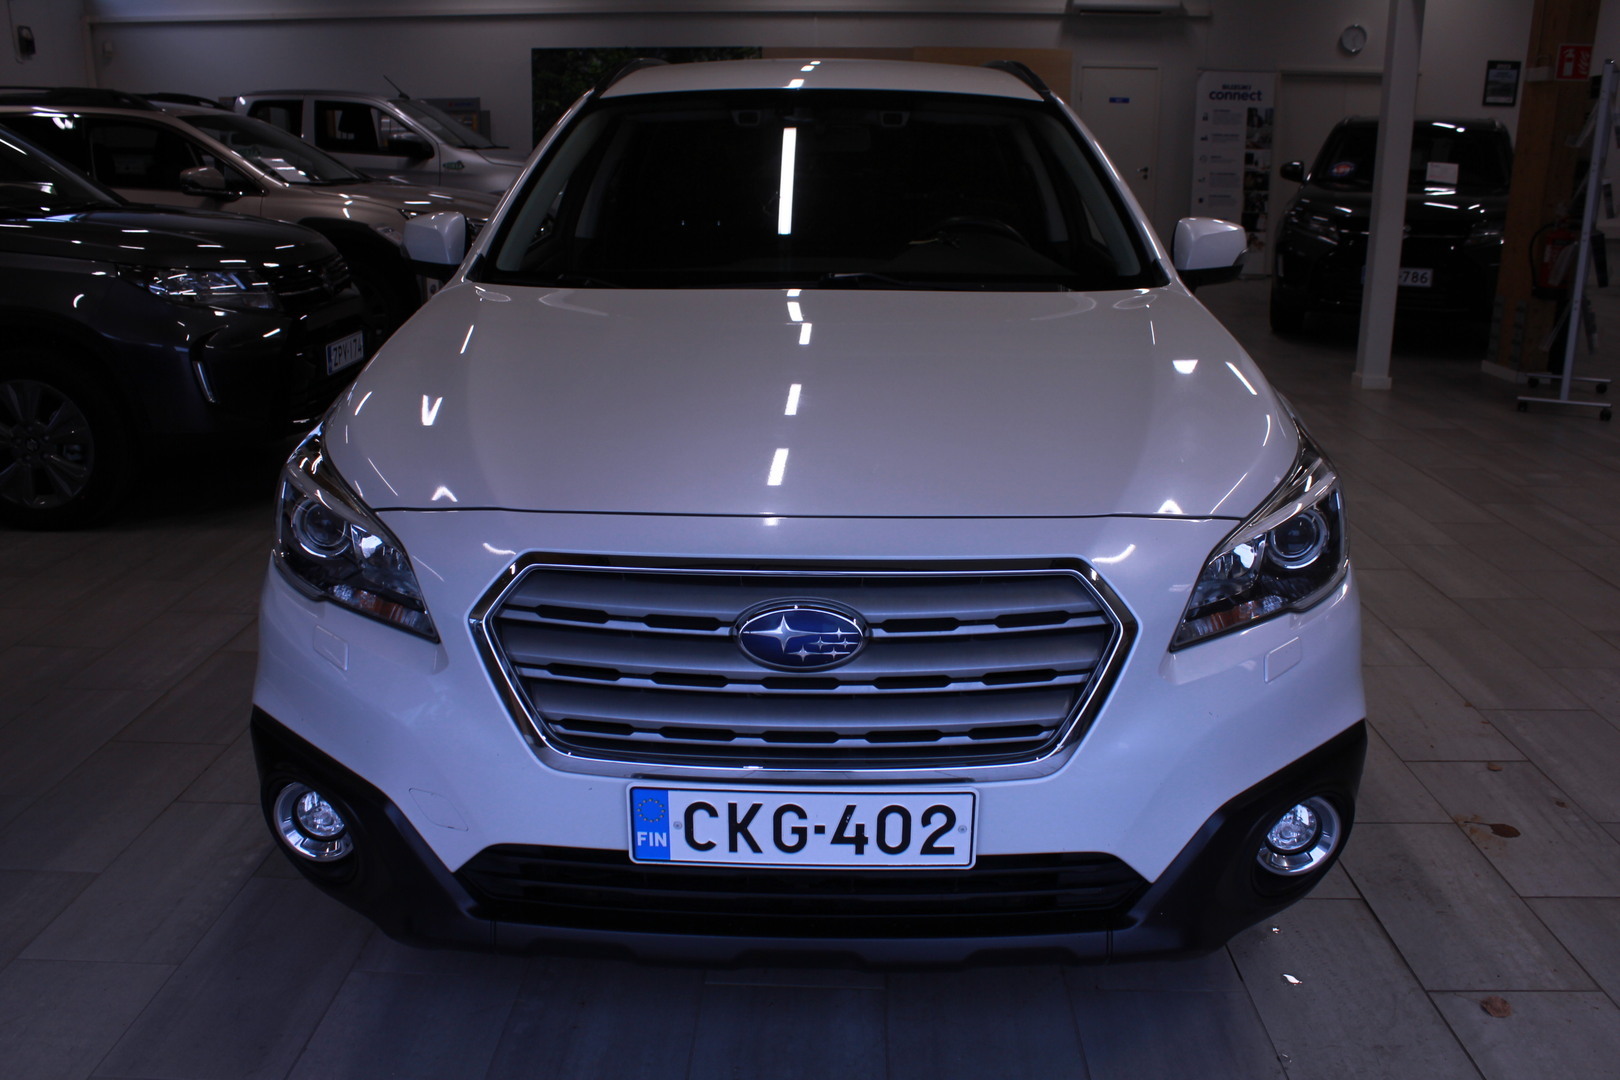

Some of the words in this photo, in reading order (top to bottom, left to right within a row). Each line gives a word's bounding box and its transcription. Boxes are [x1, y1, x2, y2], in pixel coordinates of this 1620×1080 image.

[1209, 90, 1262, 101] connect
[684, 801, 957, 855] CKG-402
[637, 831, 667, 847] FIN
